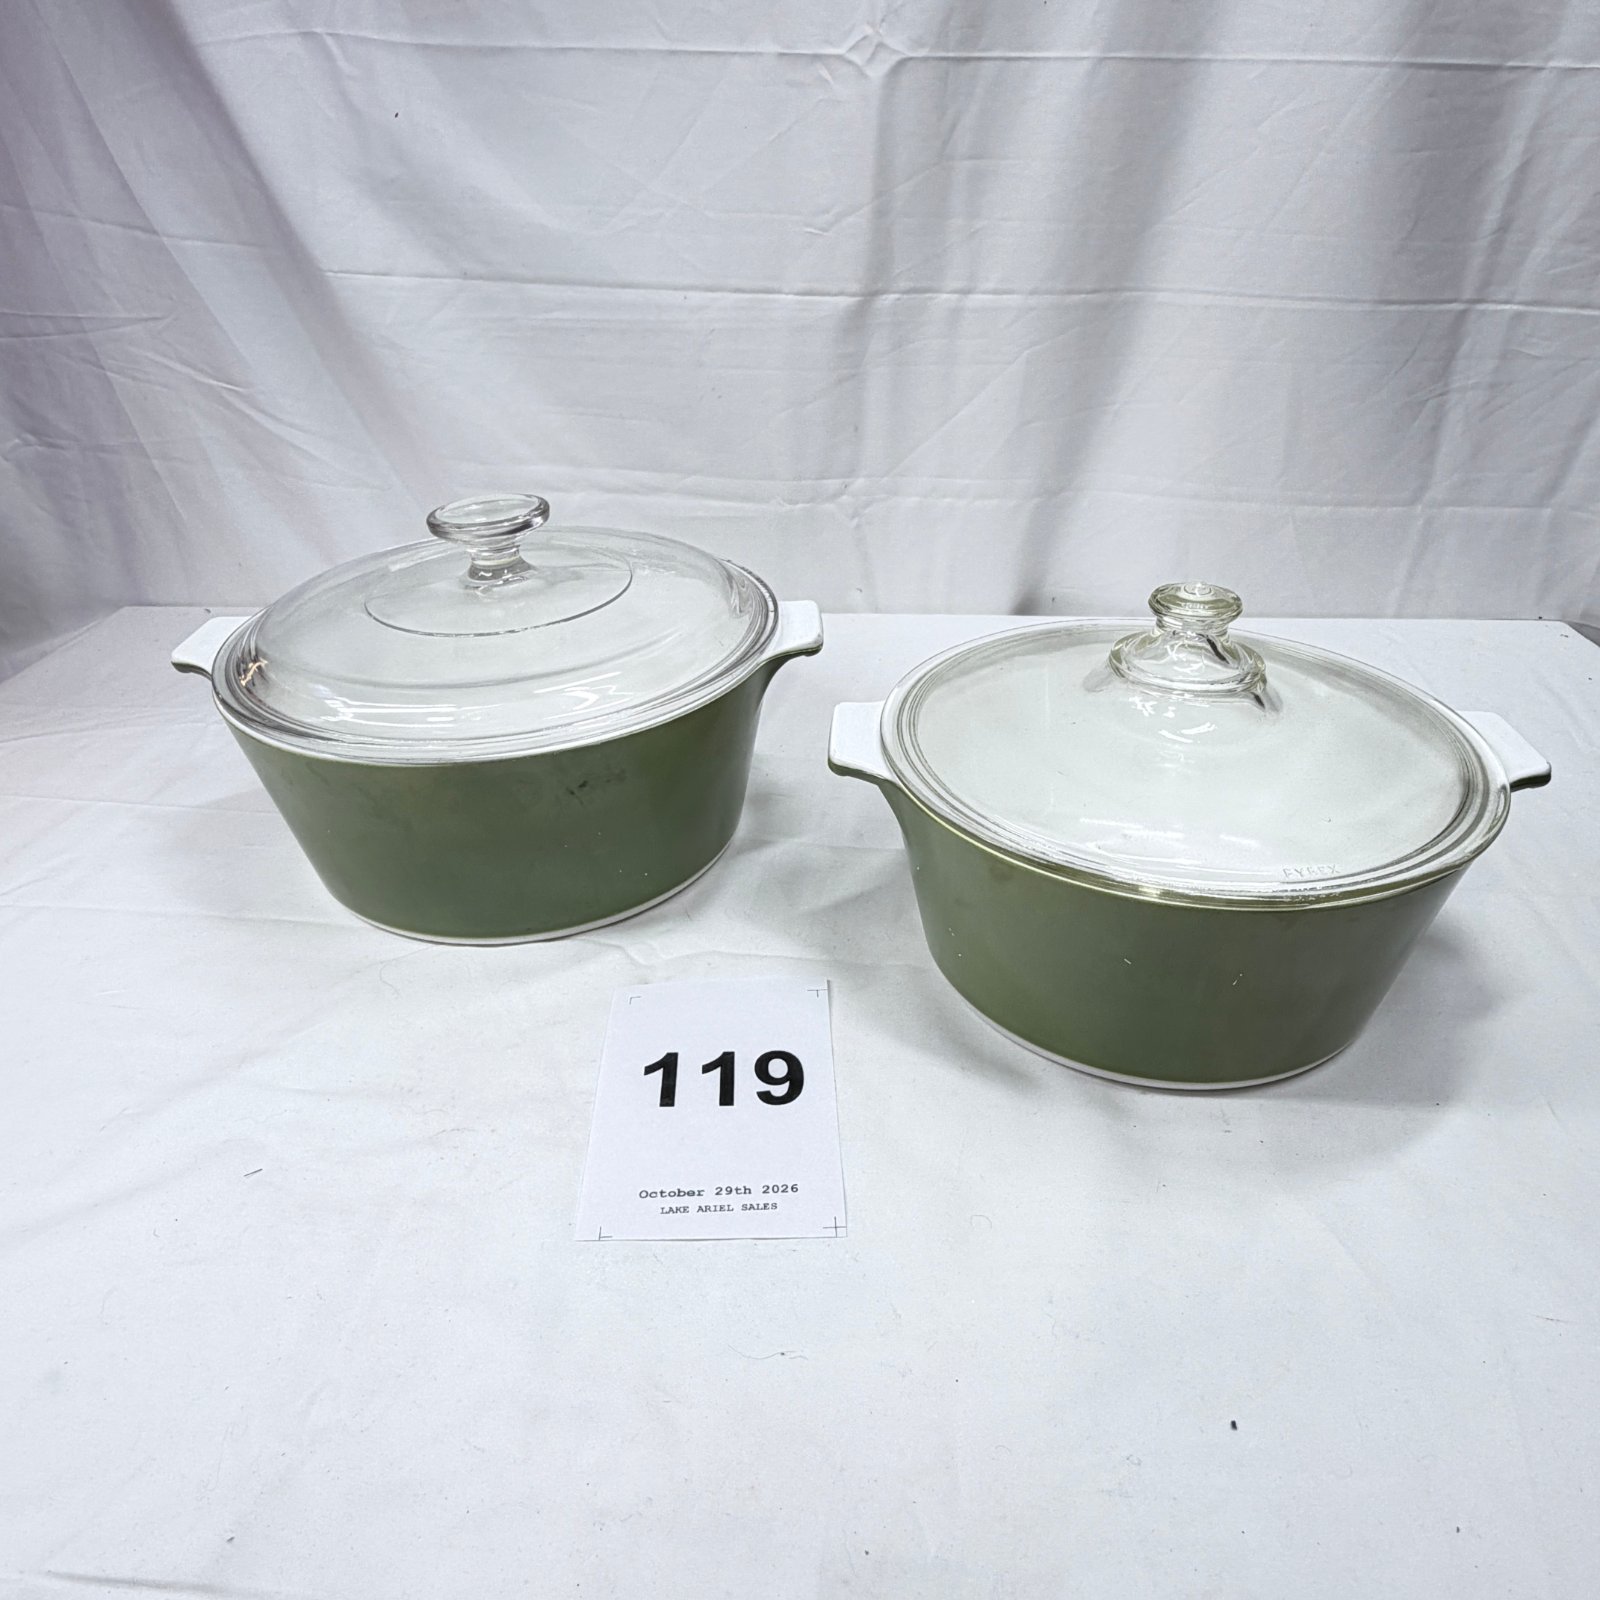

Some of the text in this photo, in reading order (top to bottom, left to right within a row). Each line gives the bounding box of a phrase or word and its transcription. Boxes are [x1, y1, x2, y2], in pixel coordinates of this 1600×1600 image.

[643, 1050, 805, 1107] 119
[639, 1183, 799, 1199] October 29th 2026
[660, 1202, 778, 1215] LAKE ARIEL SALES
